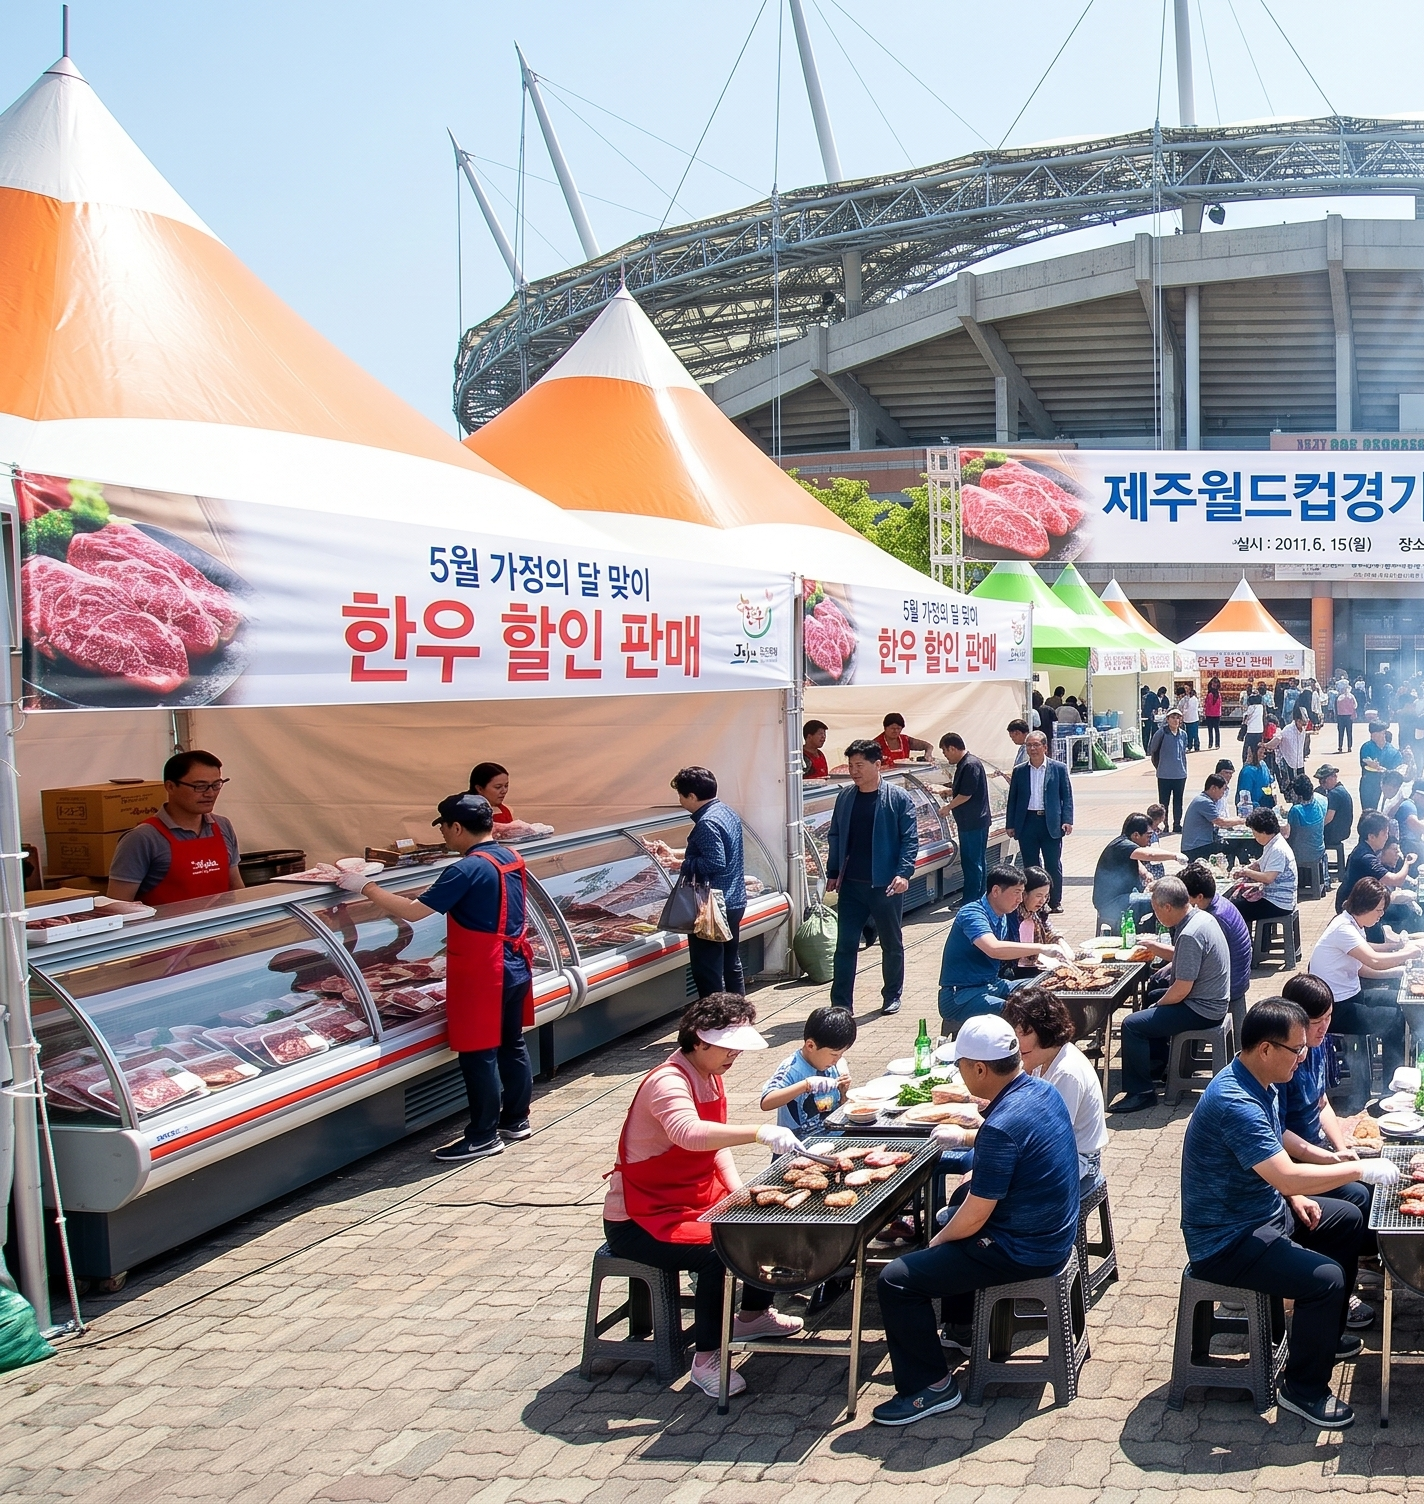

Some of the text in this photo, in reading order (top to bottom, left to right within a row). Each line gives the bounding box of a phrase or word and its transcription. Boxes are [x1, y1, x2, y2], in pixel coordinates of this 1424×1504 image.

[430, 545, 650, 602] 5월 가정의 달 맞이
[341, 591, 701, 684] 한우 할인 판매
[877, 627, 918, 675] 한우
[924, 629, 959, 674] 할인
[965, 633, 997, 673] 판매
